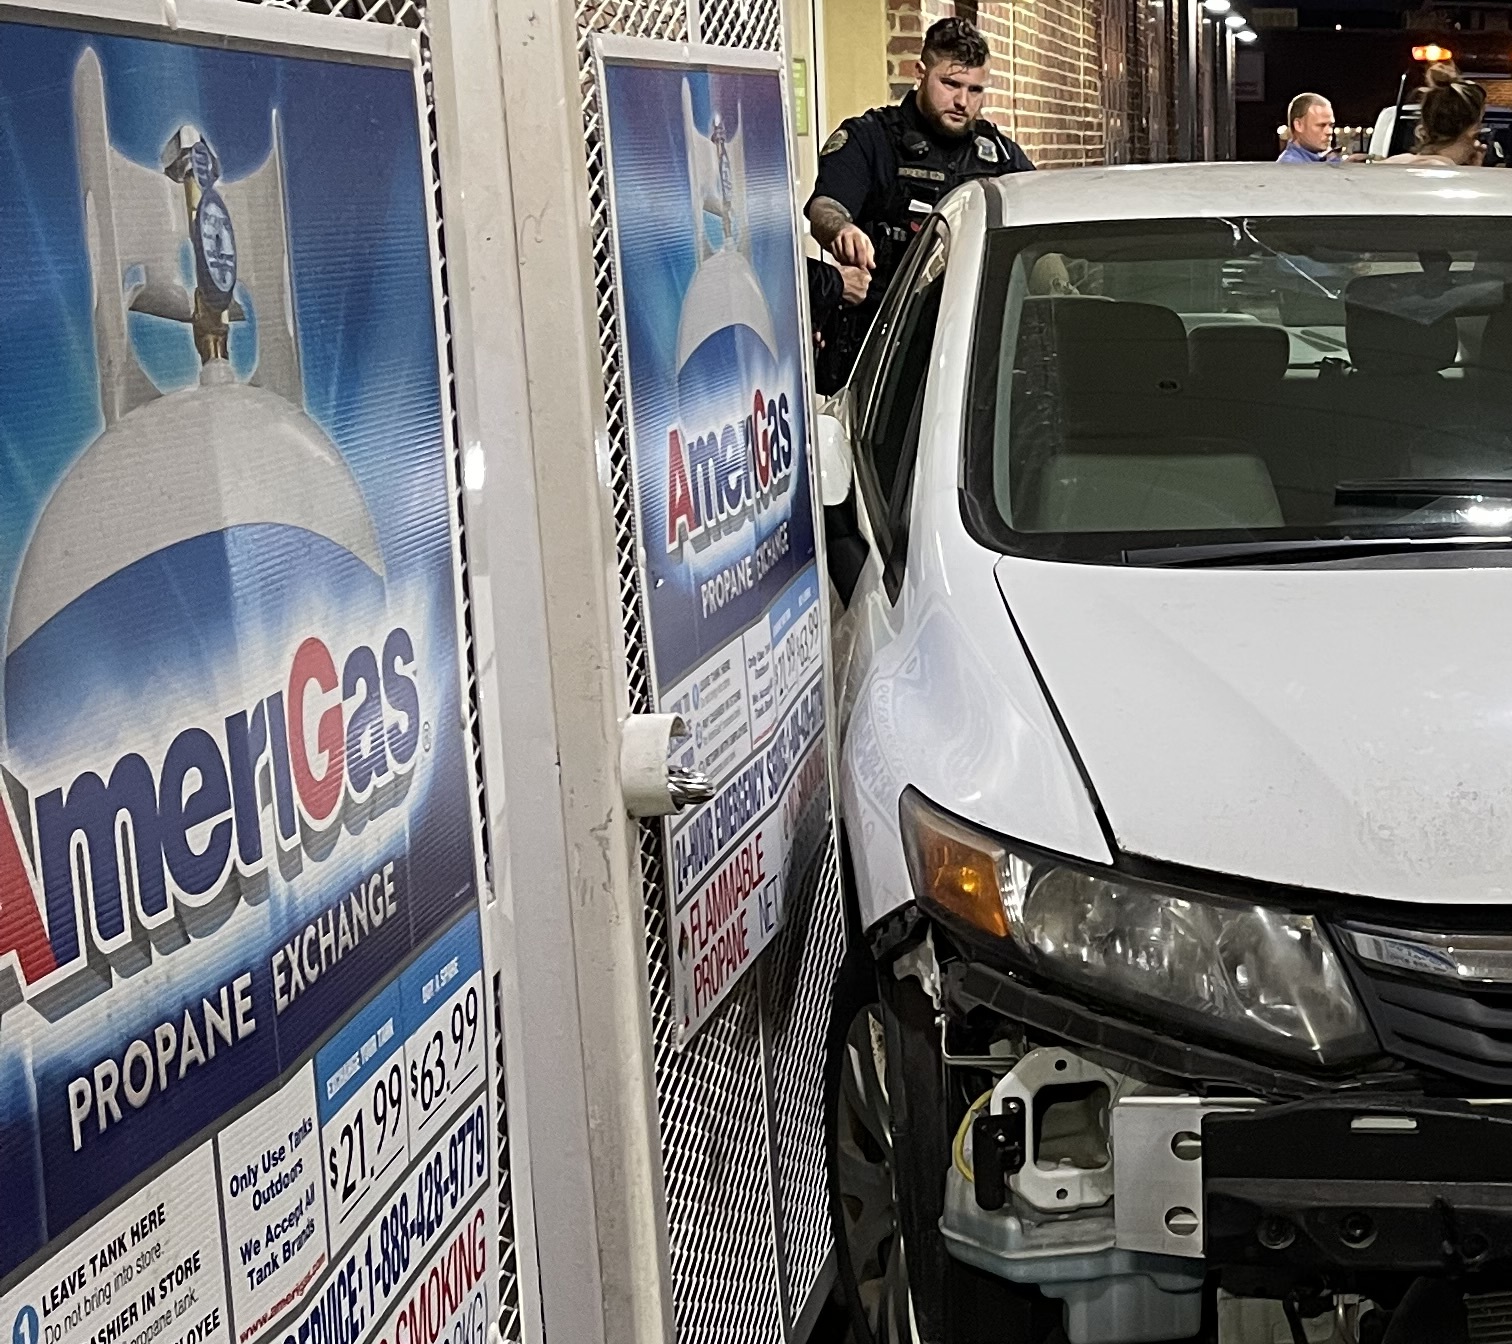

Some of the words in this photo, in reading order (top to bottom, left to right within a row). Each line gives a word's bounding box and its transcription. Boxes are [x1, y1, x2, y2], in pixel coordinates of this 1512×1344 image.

[668, 389, 793, 545] AmeriGas
[701, 557, 753, 619] PROPANE
[690, 831, 765, 959] FLAMMABLE
[68, 972, 256, 1152] PROPANE
[272, 861, 397, 1015] EXCHANGE
[693, 907, 750, 1018] PROPANE
[330, 1064, 401, 1205] $21.99
[410, 987, 478, 1112] $63.99
[229, 1164, 258, 1198] Only
[262, 1145, 286, 1175] Use
[288, 1116, 313, 1153] Tanks
[252, 1158, 304, 1212] Outdoors
[42, 1267, 87, 1318] LEAVE
[89, 1232, 128, 1276] TANK
[131, 1202, 167, 1246] HERE
[239, 1239, 261, 1266] We
[265, 1198, 304, 1249] Accept
[305, 1181, 316, 1212] All
[247, 1252, 279, 1291] Tank
[282, 1216, 315, 1264] Brands
[365, 1104, 485, 1318] 1-888-428-9779
[64, 1303, 82, 1335] not
[82, 1282, 112, 1317] bring
[113, 1263, 134, 1294] into
[142, 1292, 156, 1316] IN
[159, 1250, 202, 1299] STORE
